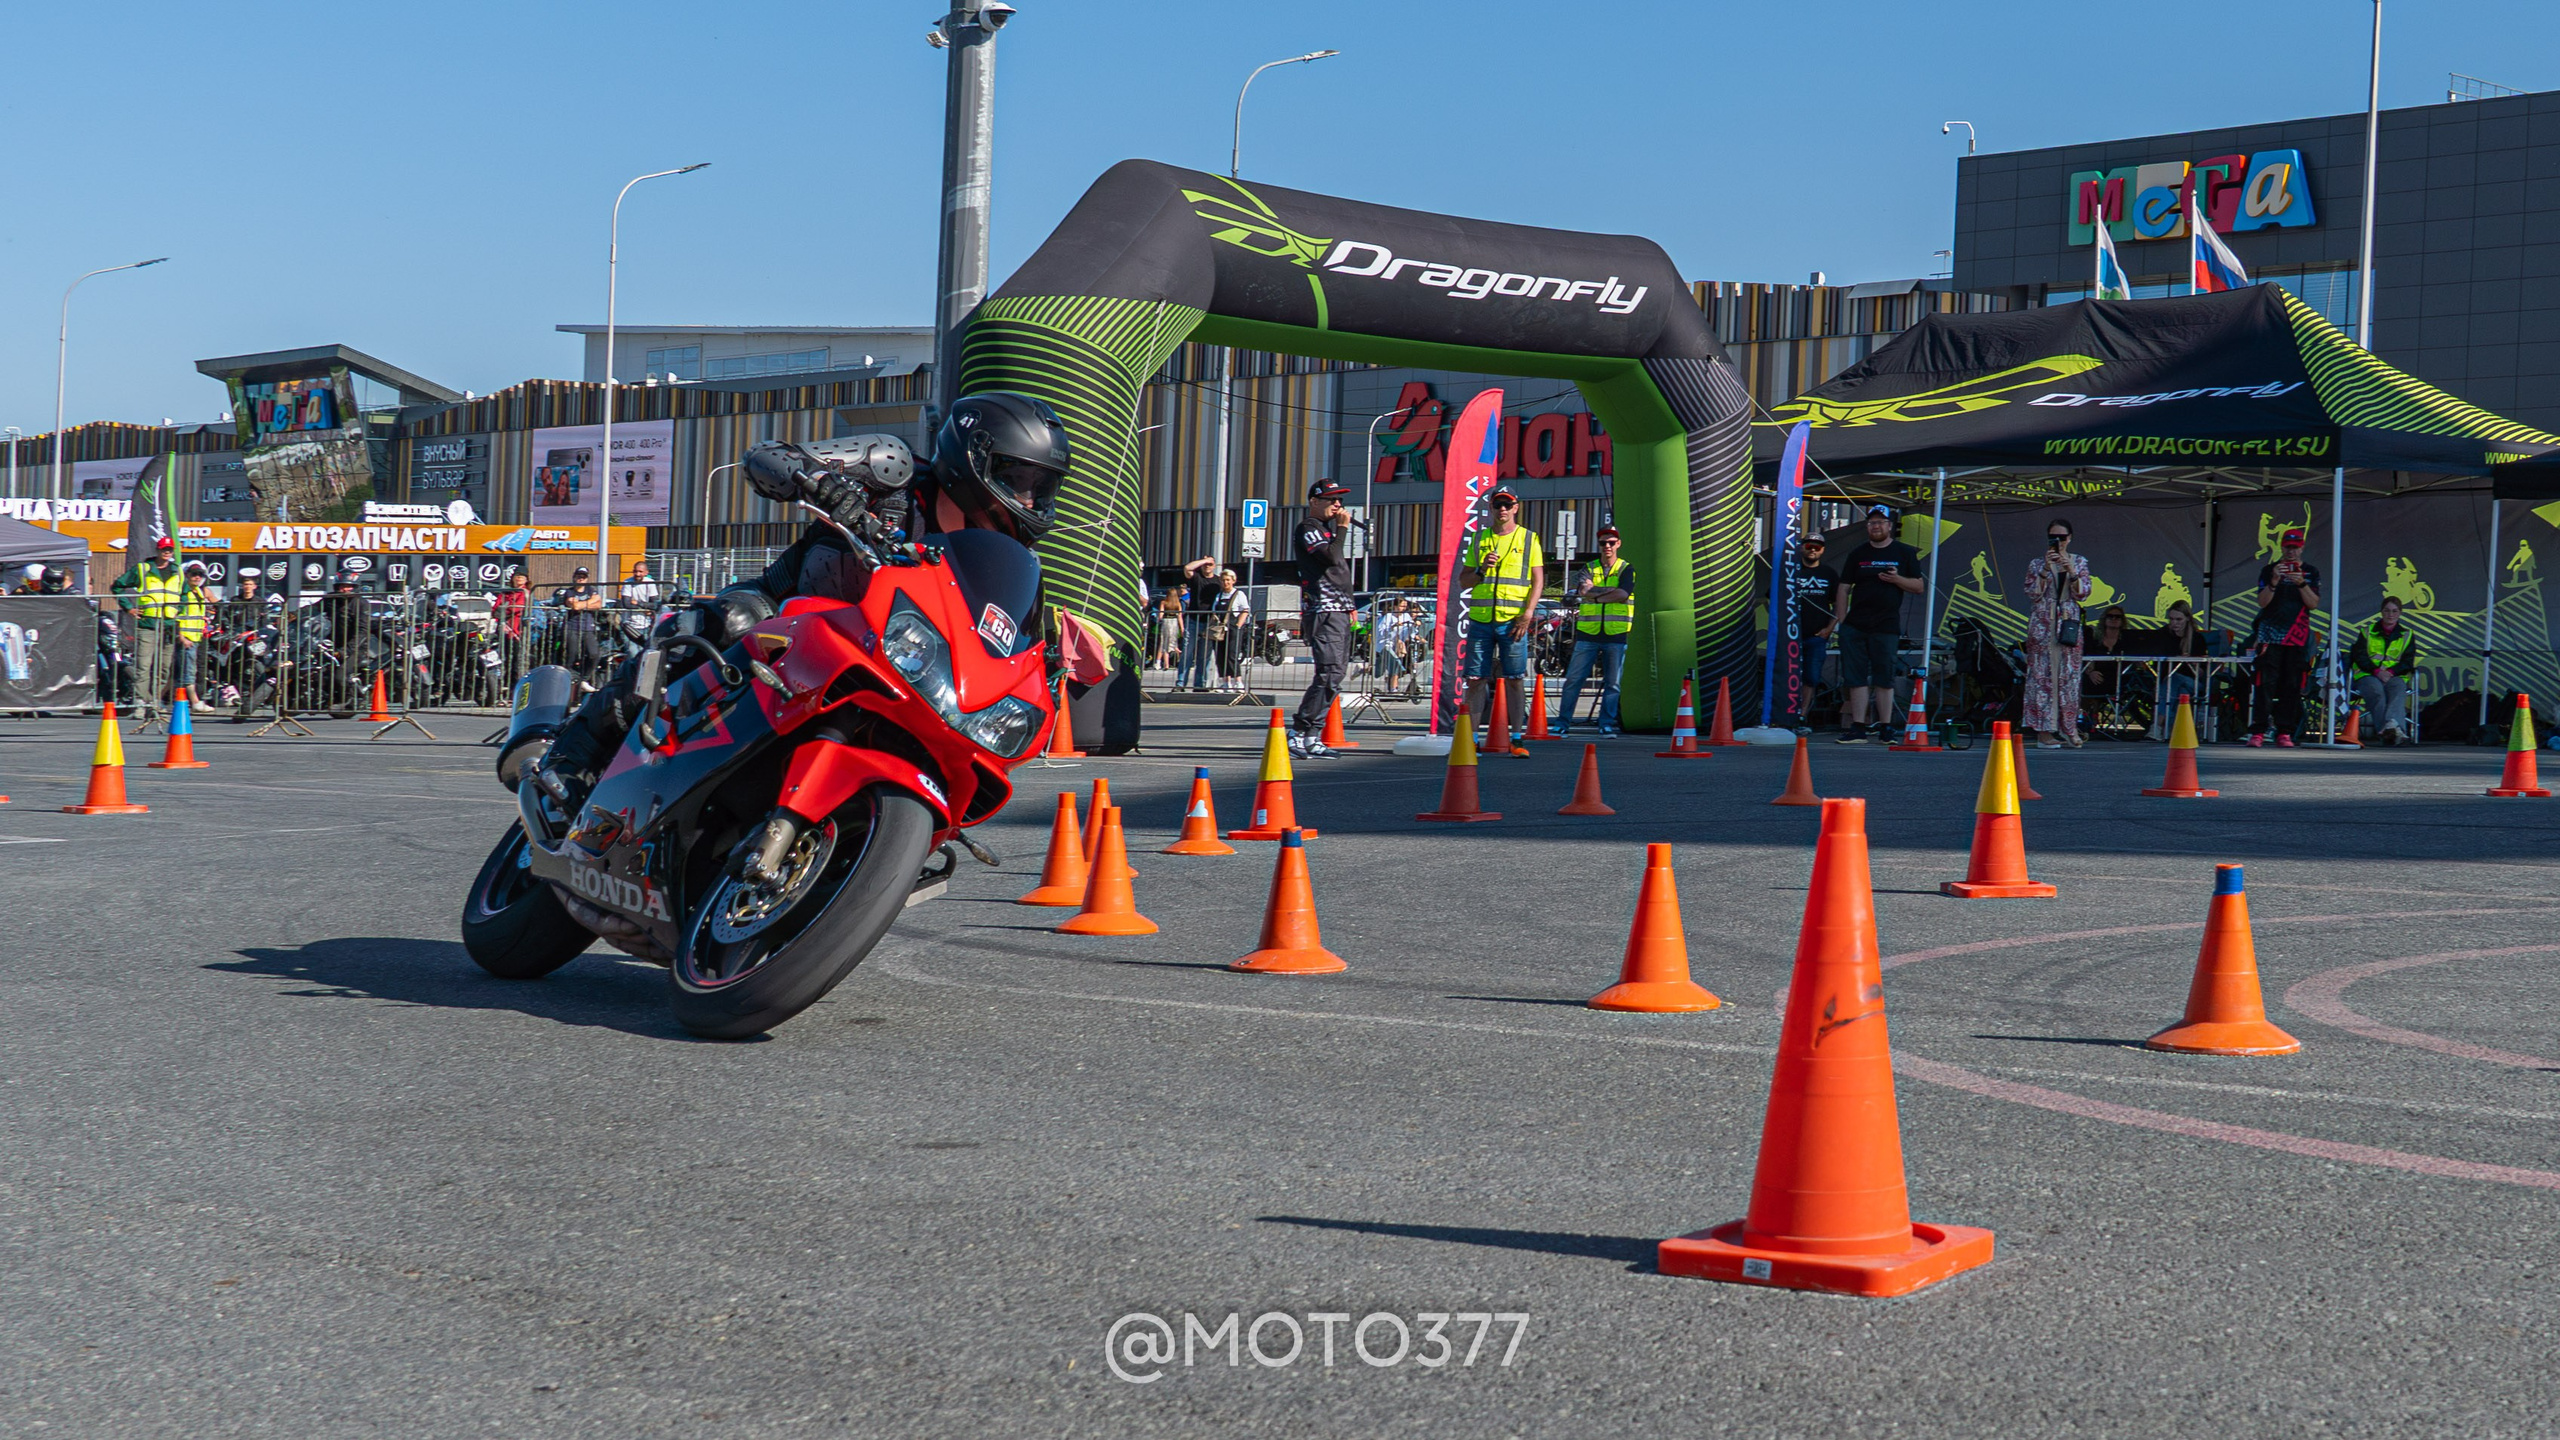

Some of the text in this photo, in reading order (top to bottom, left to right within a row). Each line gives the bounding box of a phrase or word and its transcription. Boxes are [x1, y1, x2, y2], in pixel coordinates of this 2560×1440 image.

[2043, 435, 2331, 457] WWW.DRAGON-FLY.SU
[178, 526, 212, 537] ВТО
[254, 525, 467, 551] АВТОЗАПЧАСТИ
[532, 530, 570, 540] АВТО
[179, 538, 232, 549] ПОНЕЦ
[530, 540, 597, 551] ЕВРОПЕЕЦ
[1785, 497, 1800, 714] MOTOGYMKHANA
[569, 859, 671, 923] HONDA
